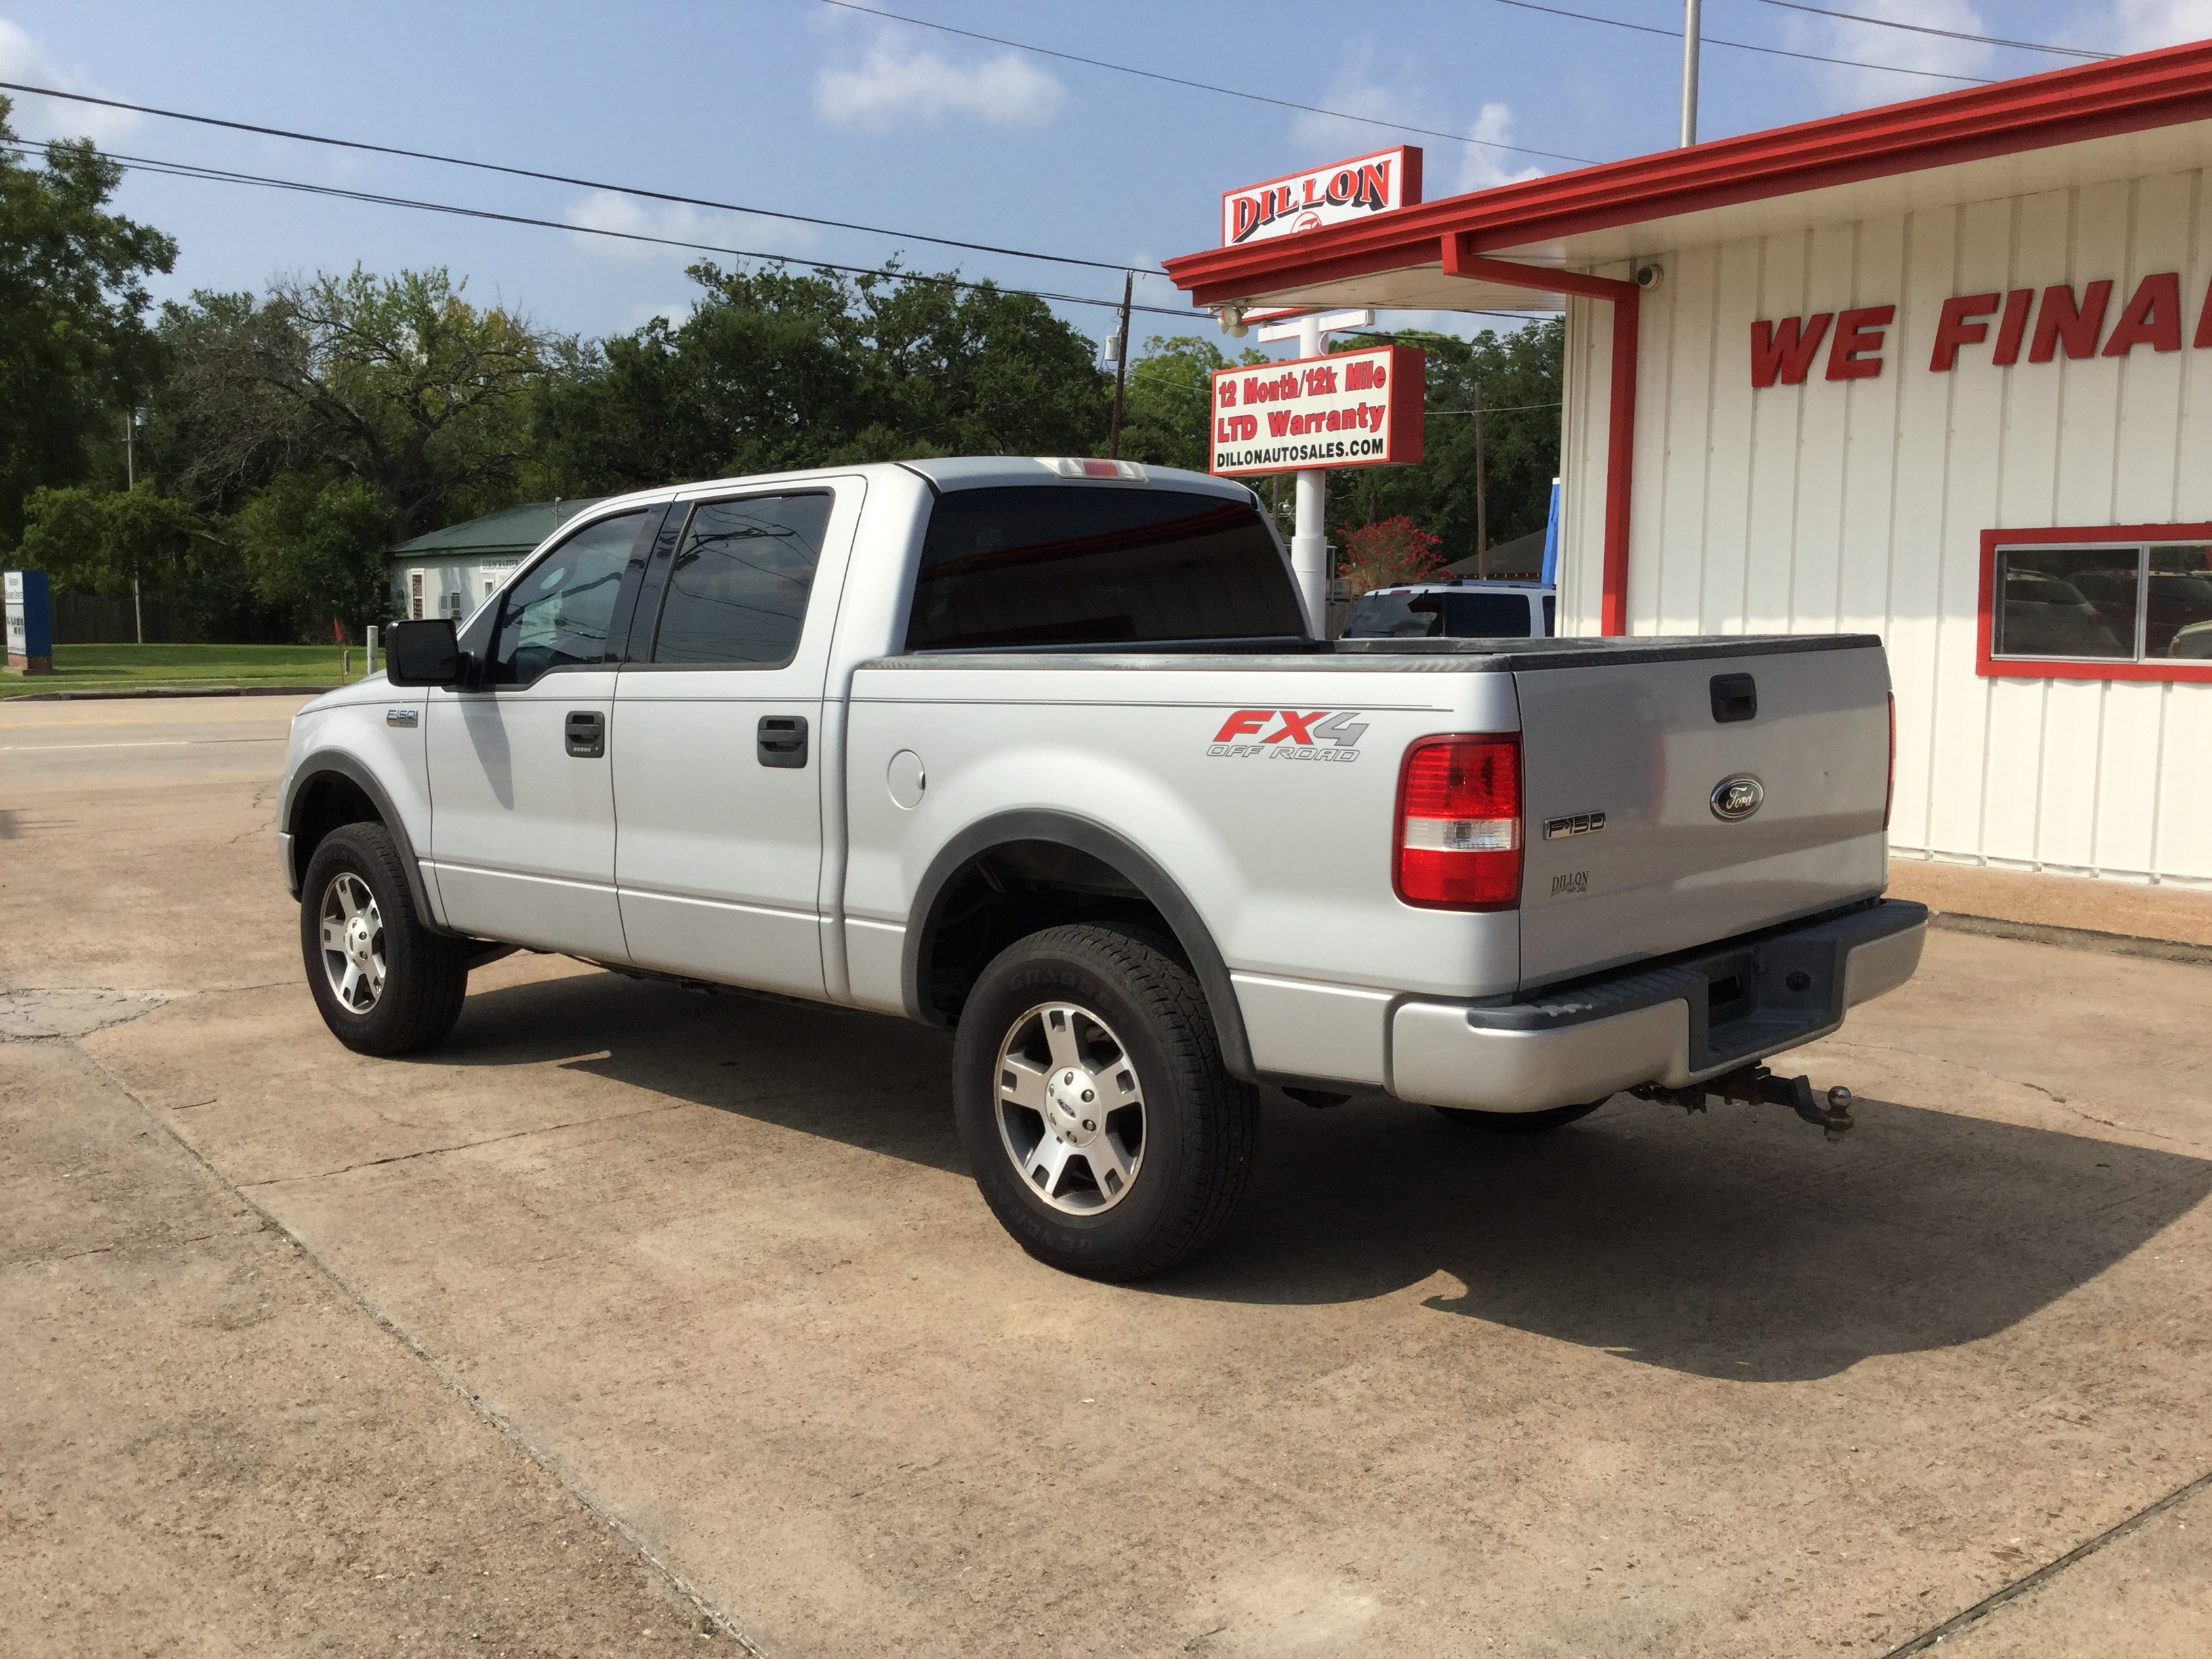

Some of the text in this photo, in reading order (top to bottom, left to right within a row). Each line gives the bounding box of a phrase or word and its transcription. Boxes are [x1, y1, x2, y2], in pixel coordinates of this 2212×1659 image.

[1231, 159, 1392, 244] DILLON
[1750, 271, 2212, 388] WE FINA
[1218, 360, 1387, 408] 12 Month/12k Mile
[1218, 402, 1387, 444] LTD Warranty
[1217, 437, 1384, 468] DILLONAUTOSALES.COM
[1212, 710, 1370, 747] FX4
[1206, 744, 1361, 762] OFF ROAD
[1726, 787, 1754, 810] Ford
[1547, 811, 1605, 838] F-150
[1551, 869, 1590, 893] DILLON
